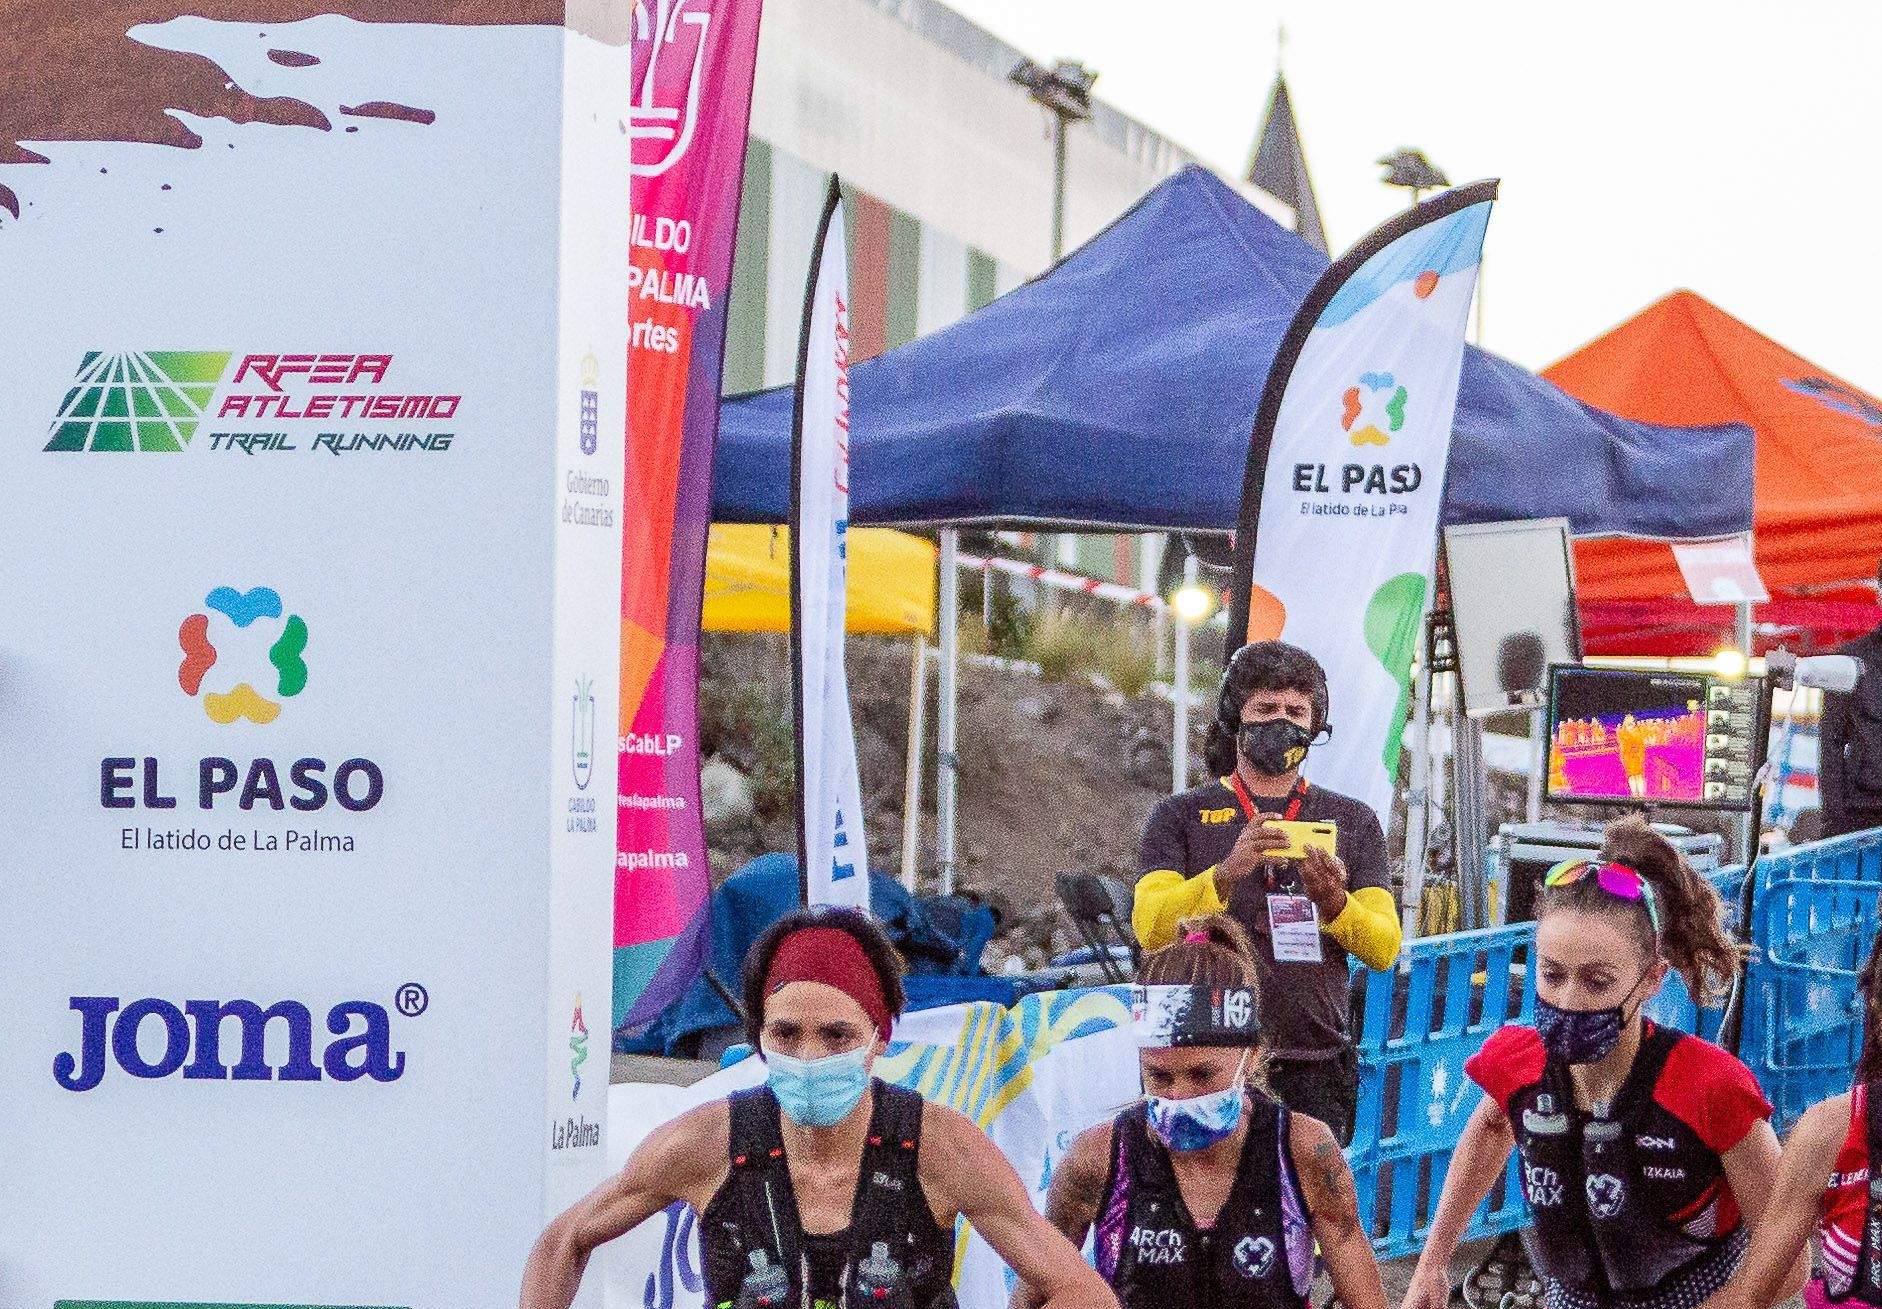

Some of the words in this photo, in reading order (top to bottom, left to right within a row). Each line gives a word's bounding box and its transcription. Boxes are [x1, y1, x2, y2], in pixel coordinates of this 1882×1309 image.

[630, 213, 692, 254] ILDO
[628, 265, 711, 311] PALMA
[629, 317, 679, 353] rtes
[233, 354, 393, 391] RFEA
[217, 395, 462, 421] ATLETISMO
[209, 432, 296, 453] TRAIL
[311, 432, 456, 454] RUNNING
[566, 469, 610, 498] Gobierno
[1292, 463, 1329, 493] EL
[562, 497, 573, 524] de
[573, 500, 614, 528] Canarias
[1312, 502, 1350, 516] latido
[1353, 502, 1368, 517] de
[1371, 504, 1386, 518] La
[618, 733, 683, 756] sCabLP
[100, 757, 177, 810] EL
[198, 757, 385, 812] PASO
[121, 829, 139, 850] El
[145, 829, 212, 851] latido
[217, 830, 247, 851] de
[252, 831, 279, 851] La
[286, 831, 355, 853] Palma
[617, 848, 689, 872] apalma
[552, 1119, 564, 1150] La
[566, 1115, 600, 1150] Palma
[1138, 1245, 1187, 1264] MAX
